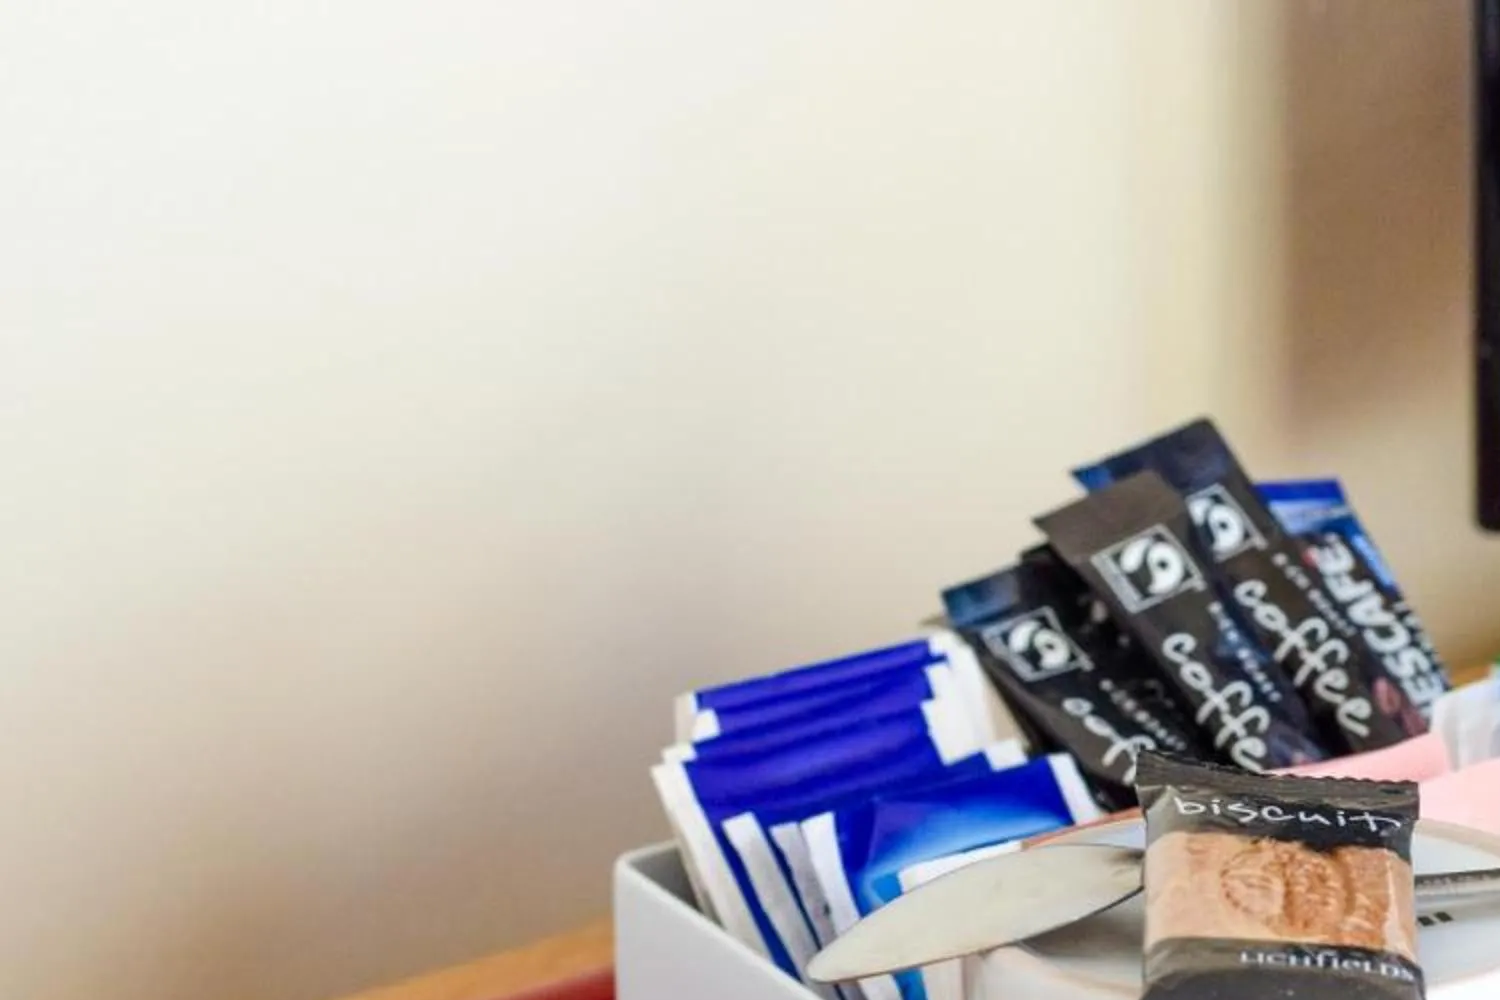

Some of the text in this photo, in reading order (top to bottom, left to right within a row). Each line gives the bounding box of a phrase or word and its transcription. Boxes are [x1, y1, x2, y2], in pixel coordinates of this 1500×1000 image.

[1235, 579, 1372, 738] coffee
[1303, 530, 1447, 718] ESCAFÉ
[1062, 697, 1155, 784] cof
[1163, 632, 1268, 772] coffe
[1174, 796, 1402, 833] biscuit
